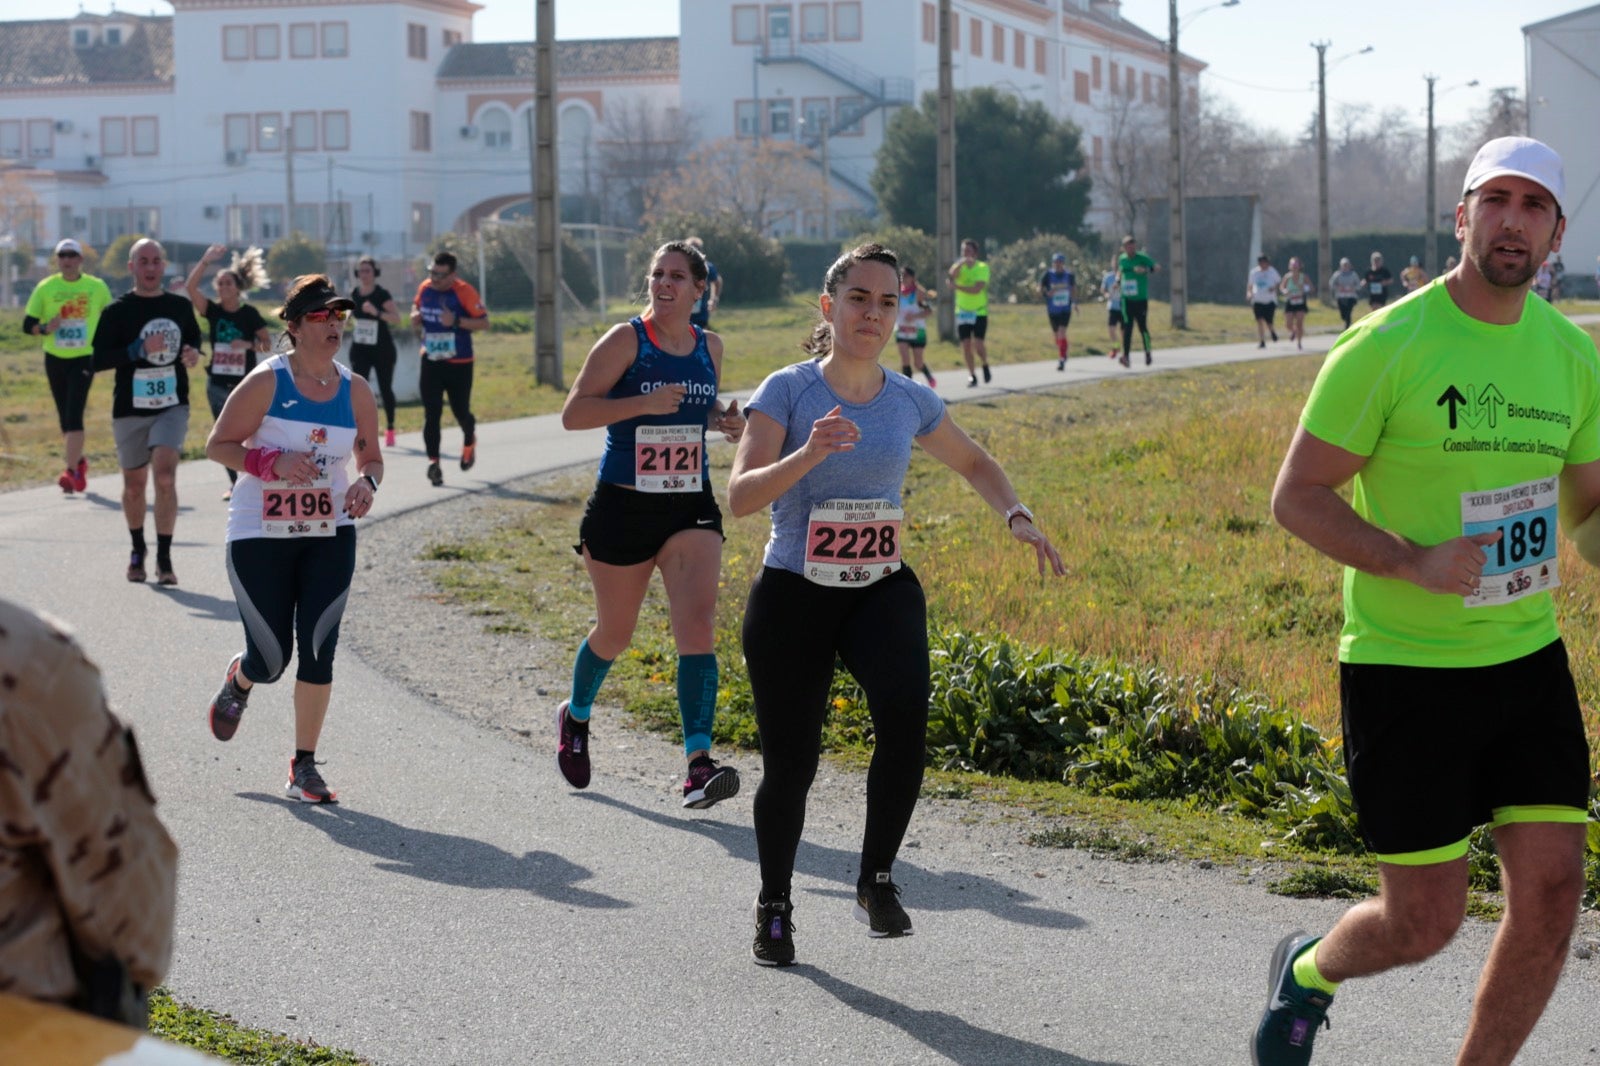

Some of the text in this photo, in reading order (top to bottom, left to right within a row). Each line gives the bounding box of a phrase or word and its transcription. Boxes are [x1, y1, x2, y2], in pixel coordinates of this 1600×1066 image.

[146, 381, 166, 396] 38
[1507, 403, 1571, 430] Bioutsourcing
[1443, 436, 1492, 453] Consultores
[1493, 436, 1502, 452] de
[1502, 437, 1536, 453] Comercio
[641, 446, 699, 471] 2121
[266, 492, 332, 517] 2196
[836, 502, 853, 511] GRAN
[854, 502, 873, 512] PREMIO
[874, 502, 880, 510] DE
[844, 511, 876, 521] DIPUTACIÓN
[812, 525, 895, 559] 2228
